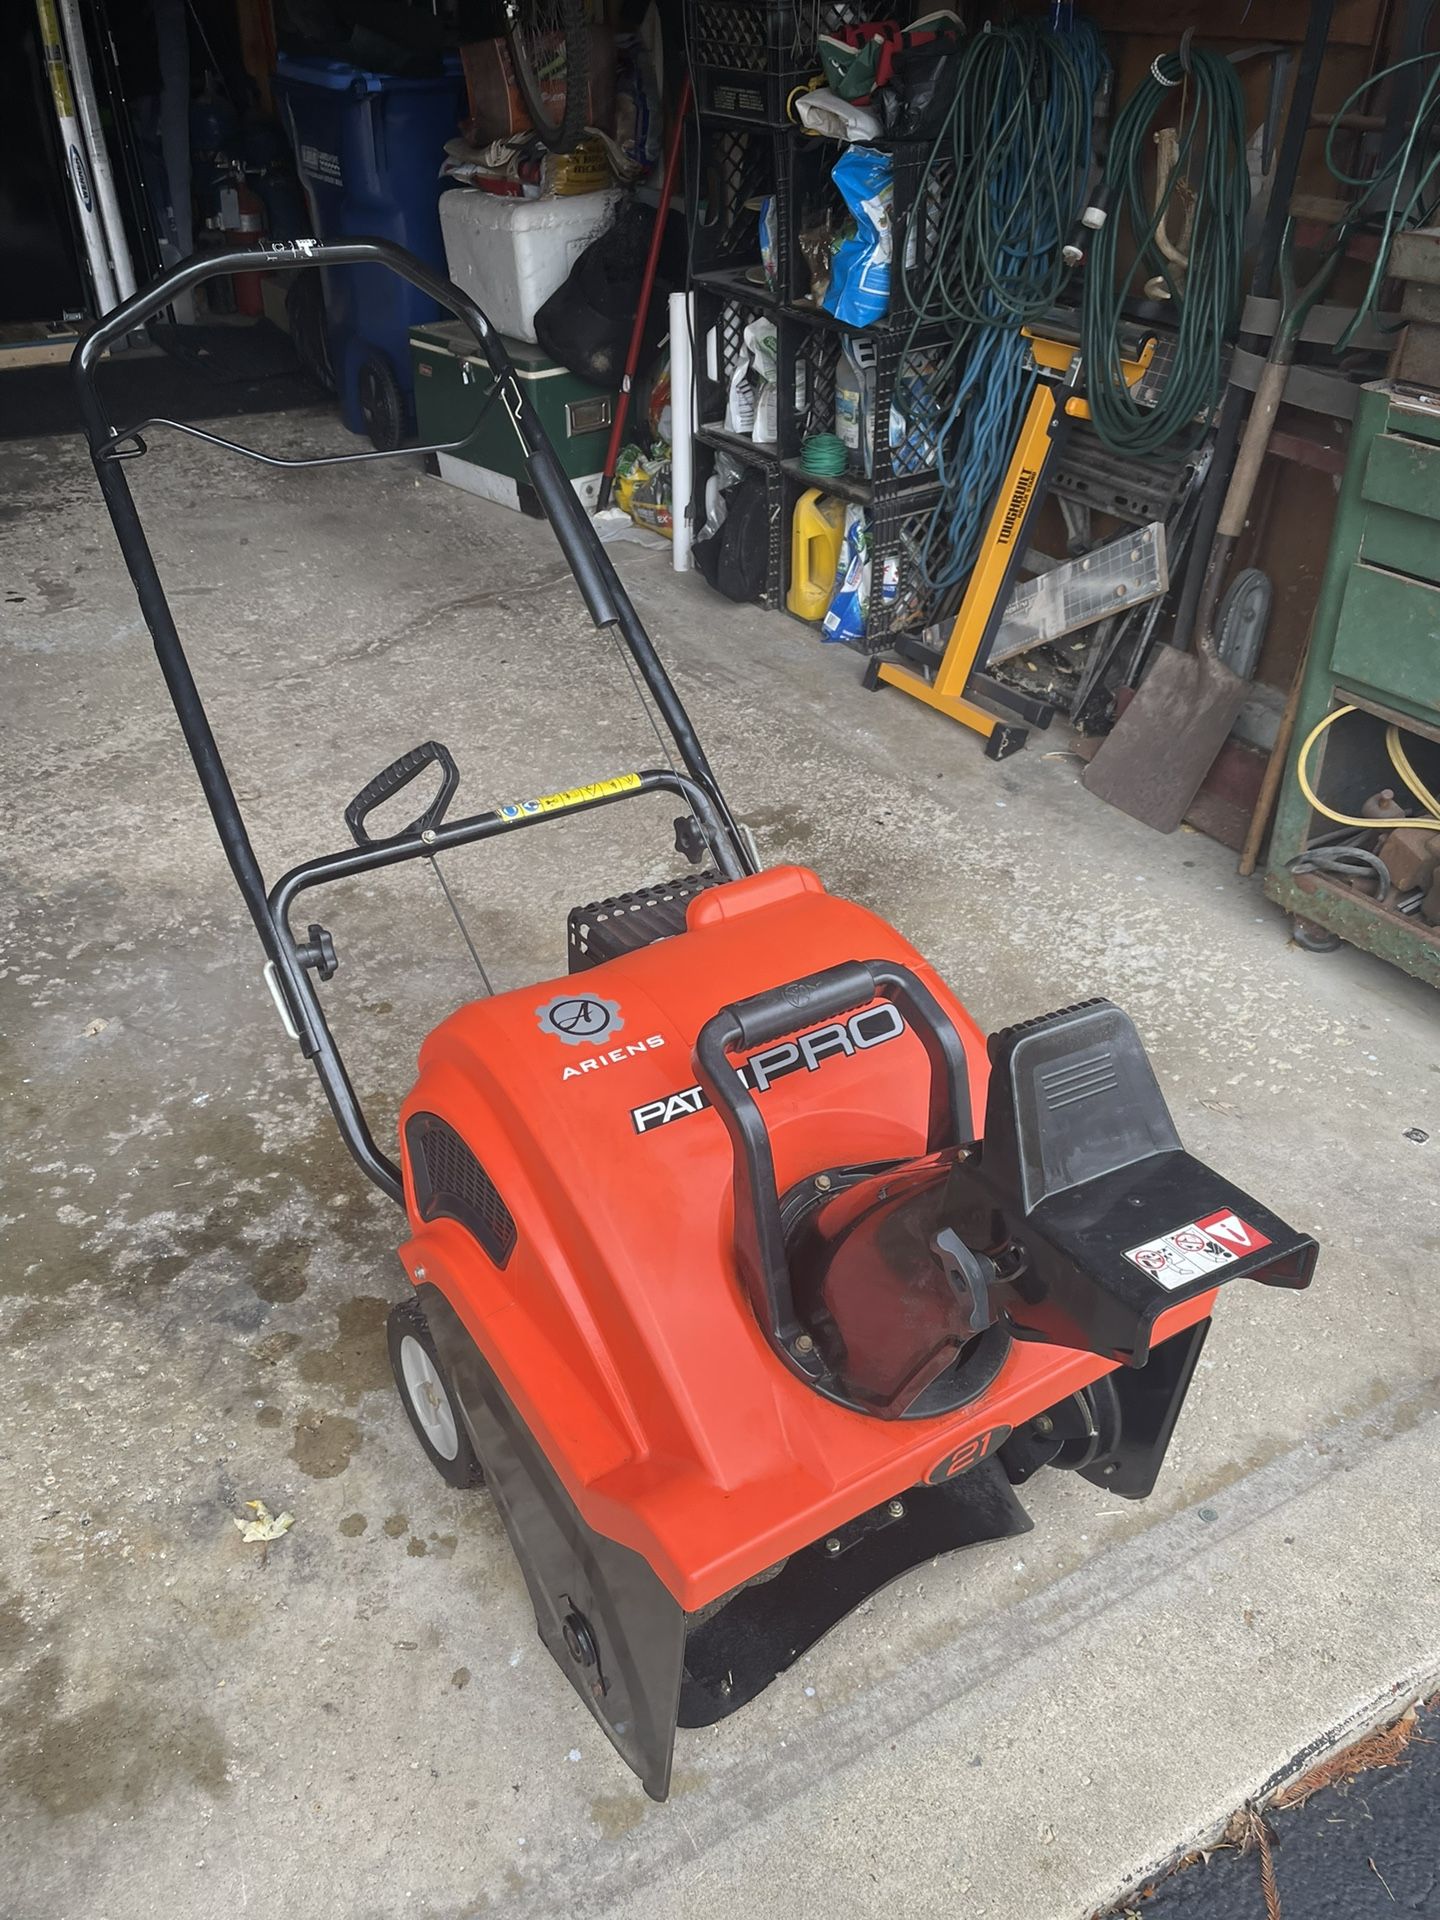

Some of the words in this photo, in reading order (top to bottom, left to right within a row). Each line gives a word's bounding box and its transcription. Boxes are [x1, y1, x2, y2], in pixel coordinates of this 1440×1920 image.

[997, 467, 1032, 545] TOUGHBUILT
[562, 1034, 666, 1081] ARIENS
[633, 1068, 749, 1132] PAT
[750, 1002, 905, 1093] PRO
[946, 1430, 993, 1478] 21
